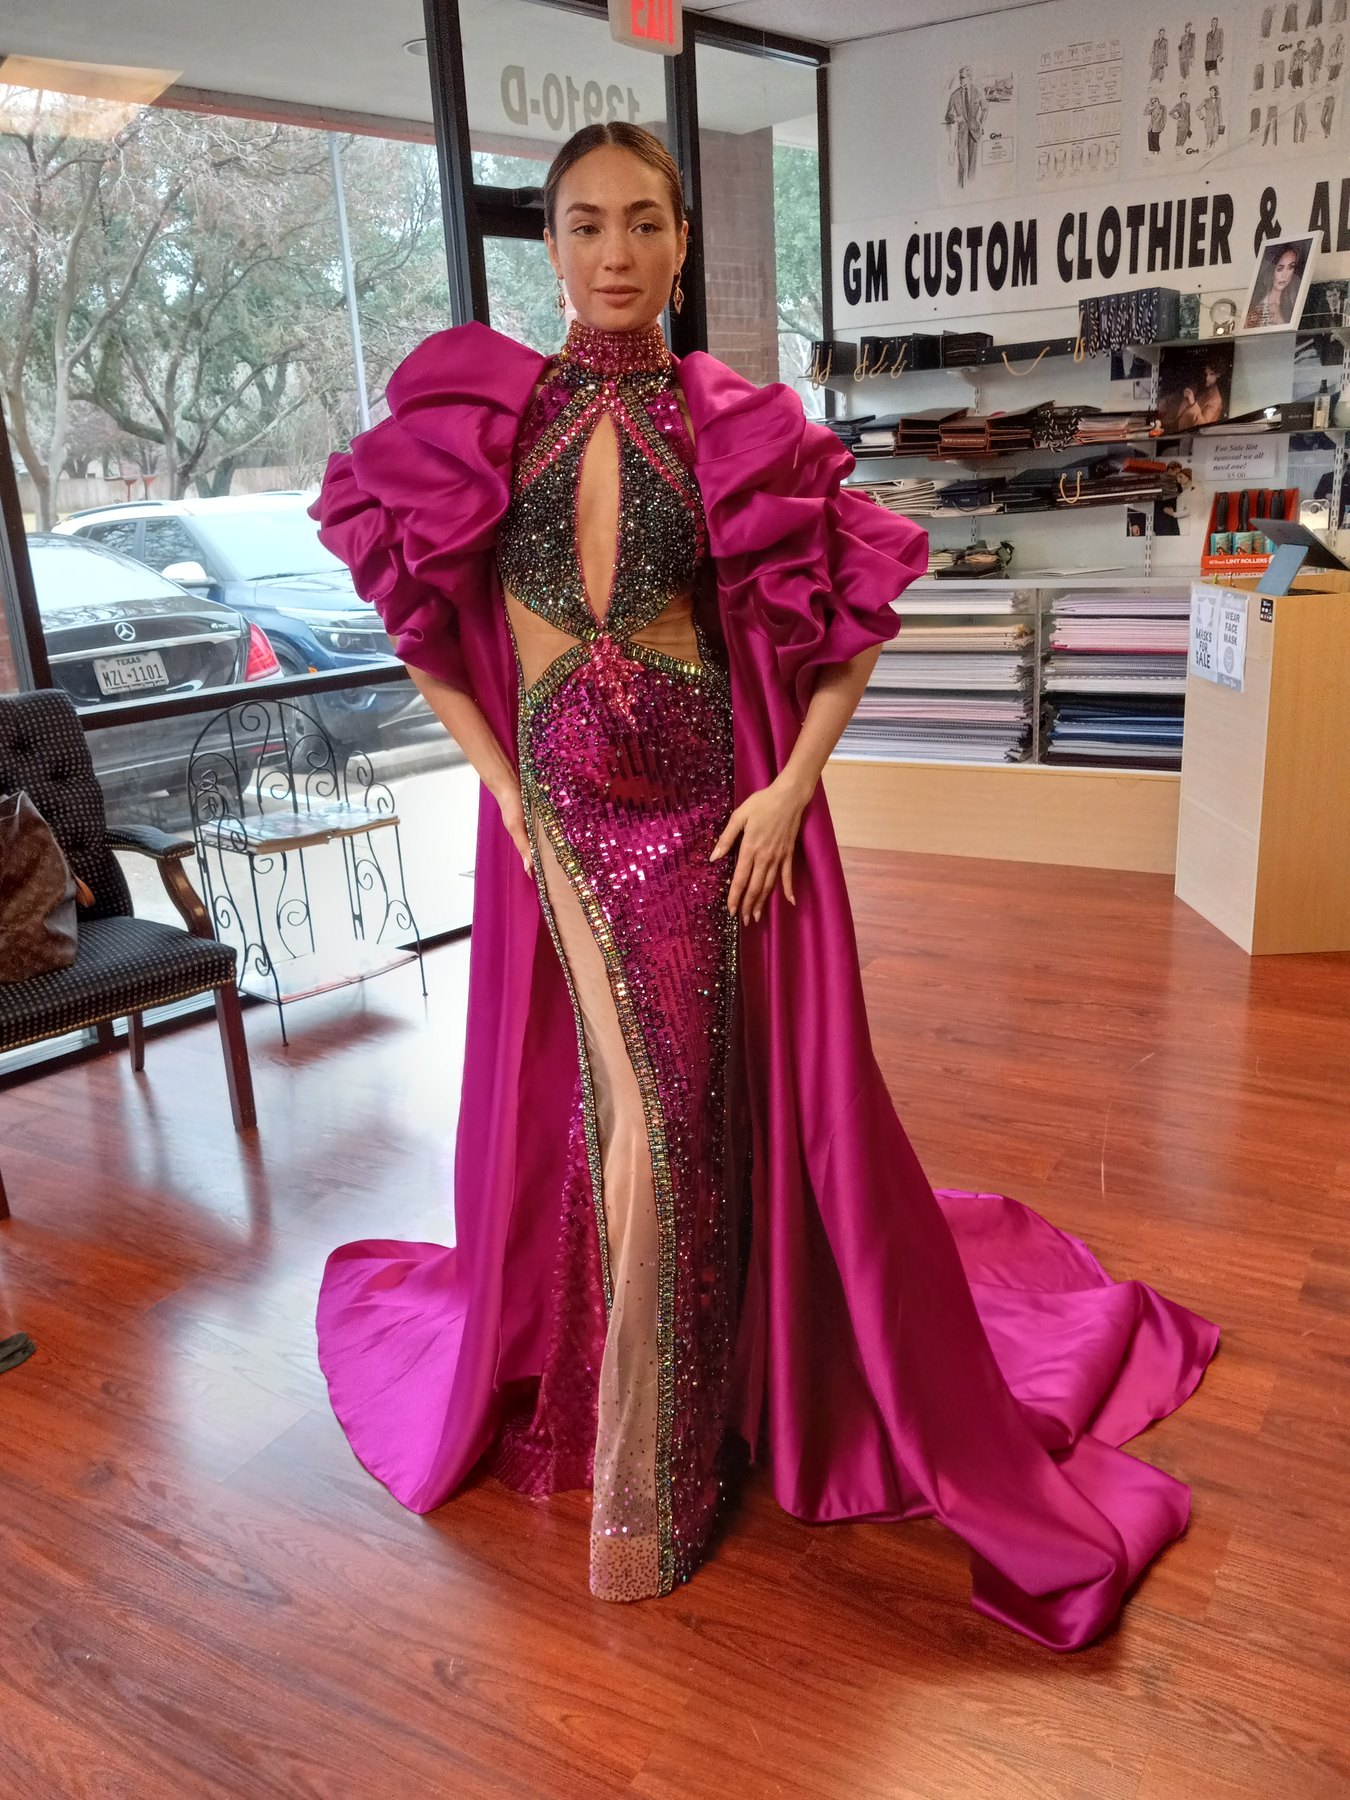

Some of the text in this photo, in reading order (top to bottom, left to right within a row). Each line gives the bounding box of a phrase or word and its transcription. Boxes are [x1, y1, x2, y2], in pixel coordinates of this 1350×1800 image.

[630, 0, 675, 46] EXIT
[843, 238, 889, 306] GM
[905, 219, 1038, 300] CUSTOM
[1057, 193, 1234, 283] CLOTHIER
[1254, 186, 1282, 259] &
[1214, 444, 1228, 452] For
[1229, 444, 1244, 452] Sale
[1213, 453, 1242, 461] removal
[1231, 462, 1247, 470] one!
[1225, 611, 1241, 622] WEAR
[1225, 622, 1238, 634] FACE
[1195, 628, 1212, 643] MASKS
[1223, 633, 1238, 646] MASK
[1199, 640, 1208, 653] FOR
[116, 656, 142, 667] TEXAS
[1195, 651, 1211, 669] SALE
